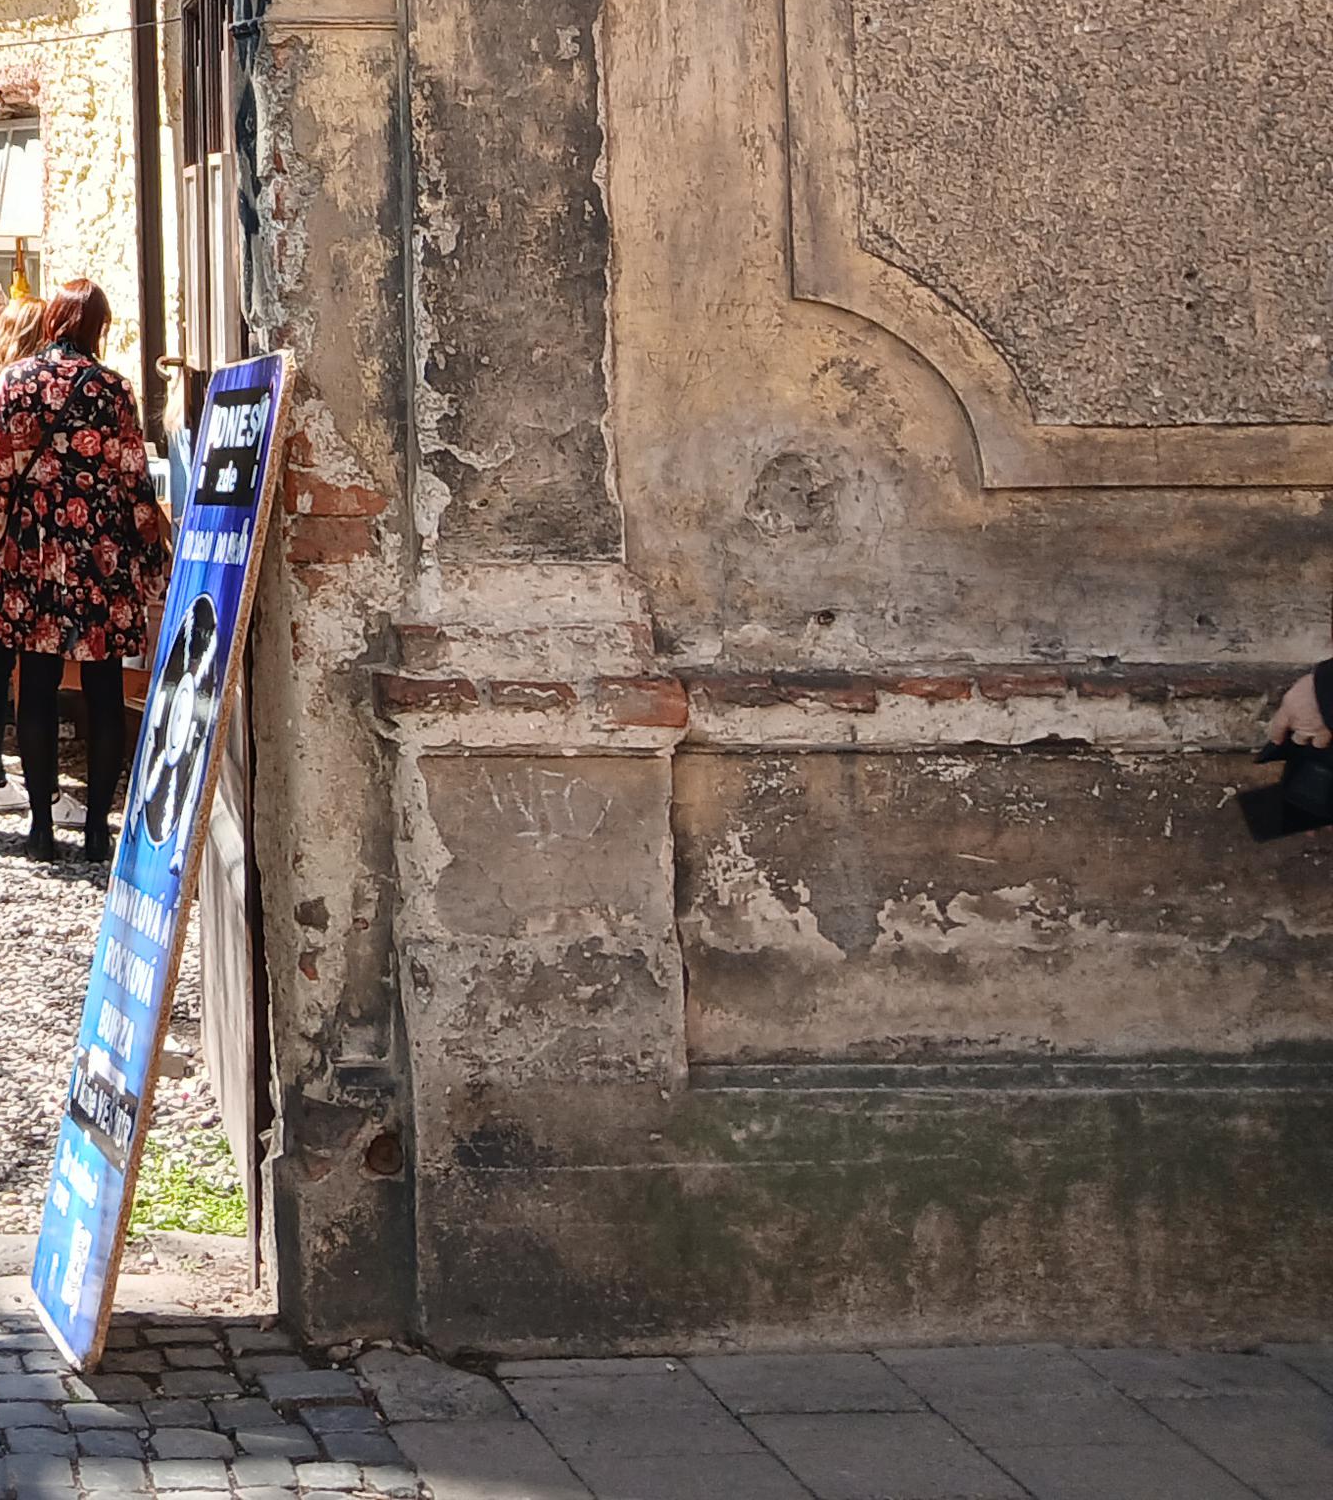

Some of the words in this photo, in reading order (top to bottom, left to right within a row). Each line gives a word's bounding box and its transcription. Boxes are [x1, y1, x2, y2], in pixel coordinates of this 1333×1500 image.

[215, 460, 237, 493] zde
[159, 909, 172, 949] A
[103, 936, 158, 1008] ROCKOVÁ
[97, 999, 135, 1063] BURZA
